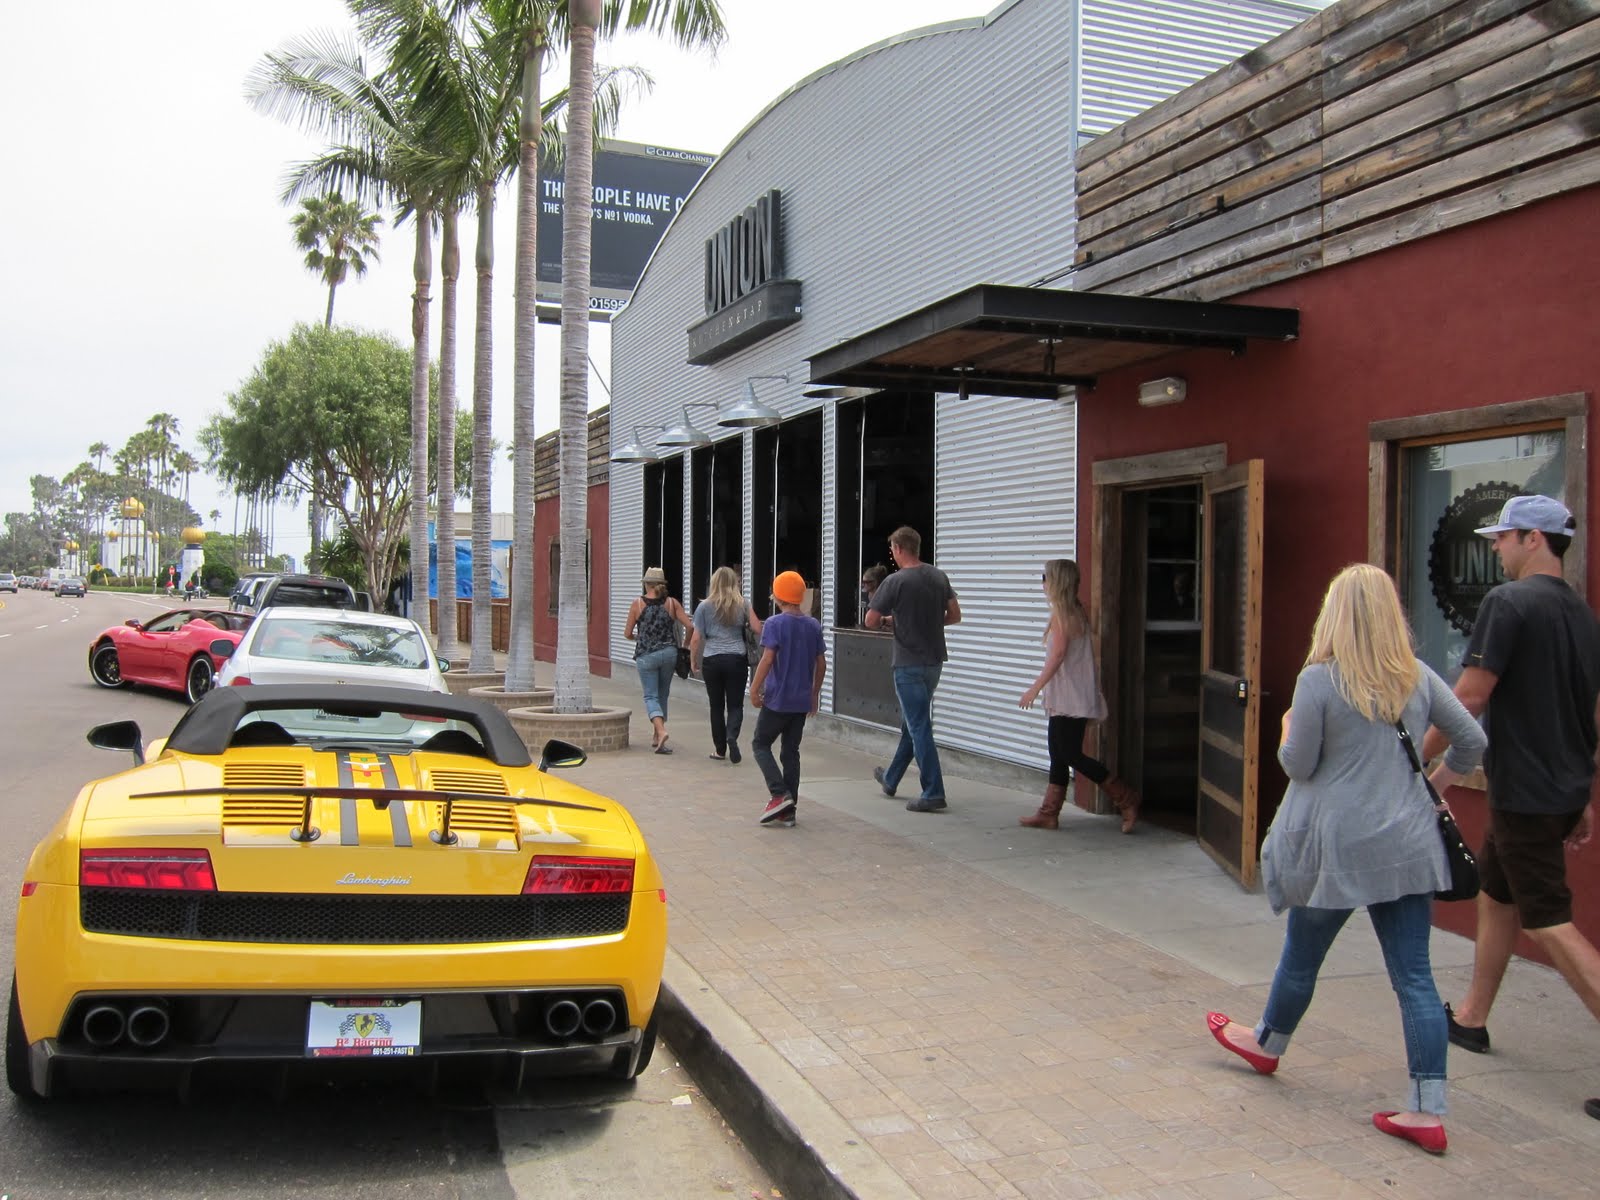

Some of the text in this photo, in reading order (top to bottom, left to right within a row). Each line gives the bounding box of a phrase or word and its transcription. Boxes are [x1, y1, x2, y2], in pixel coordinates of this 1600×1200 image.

[543, 180, 565, 199] TH
[591, 187, 631, 208] OPLE
[636, 191, 671, 212] HAVE
[543, 202, 560, 215] THE
[623, 212, 654, 226] VODKA.
[705, 190, 781, 317] UNION
[336, 872, 412, 886] Lamborghini
